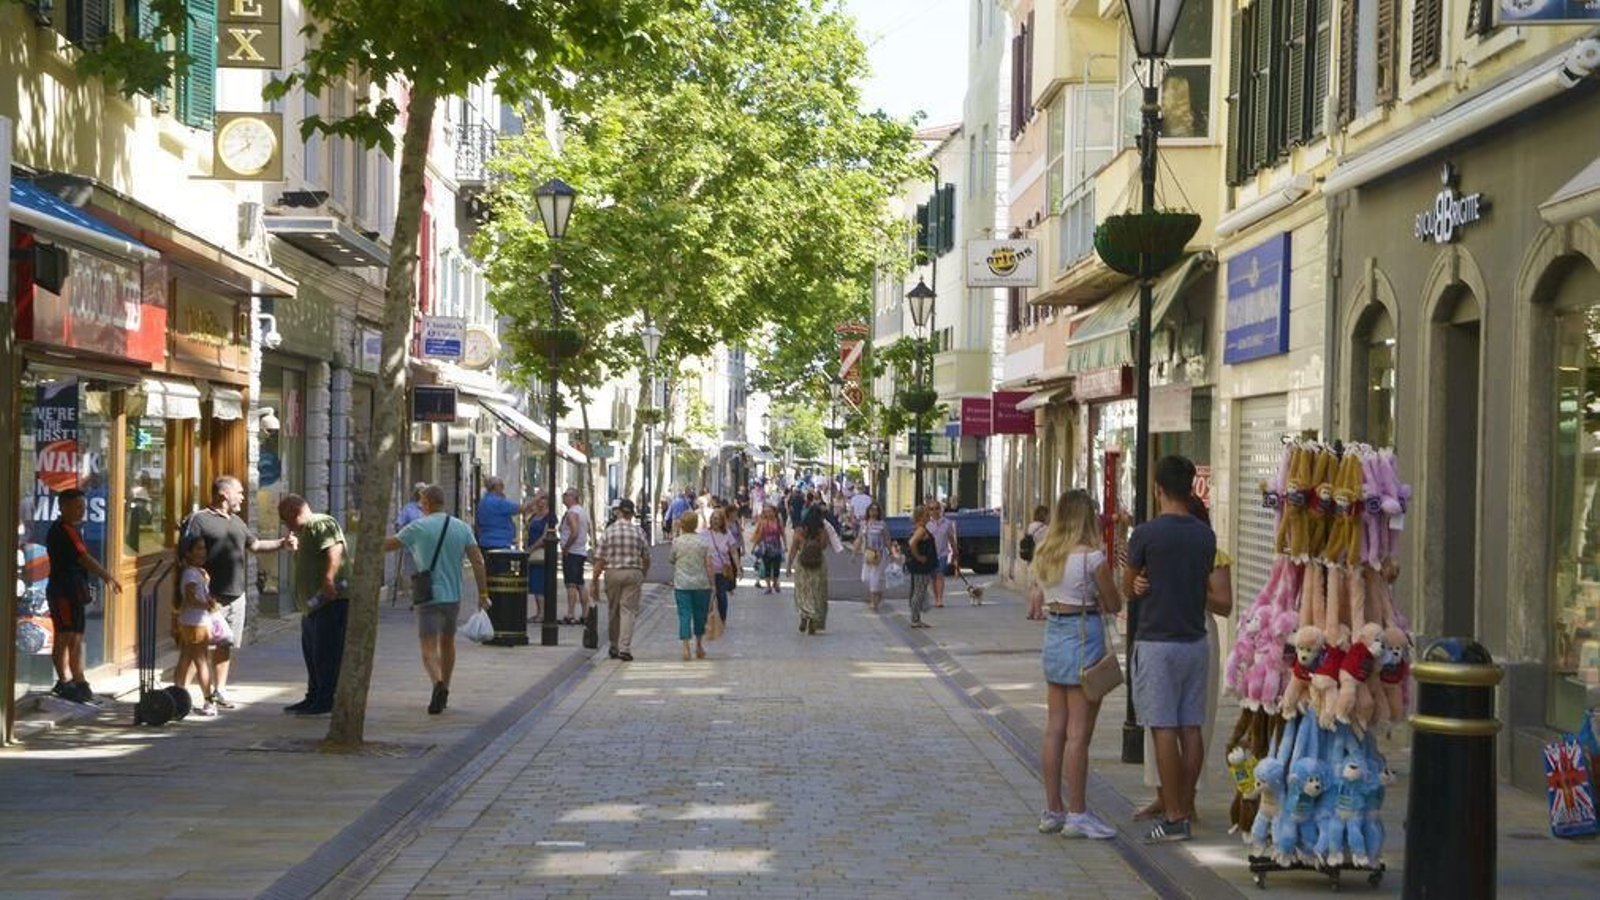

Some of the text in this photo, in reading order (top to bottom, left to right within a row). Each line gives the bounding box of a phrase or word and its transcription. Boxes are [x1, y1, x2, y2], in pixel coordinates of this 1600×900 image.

[43, 420, 62, 431] THE
[36, 452, 100, 473] WALK
[26, 496, 106, 522] MAS
